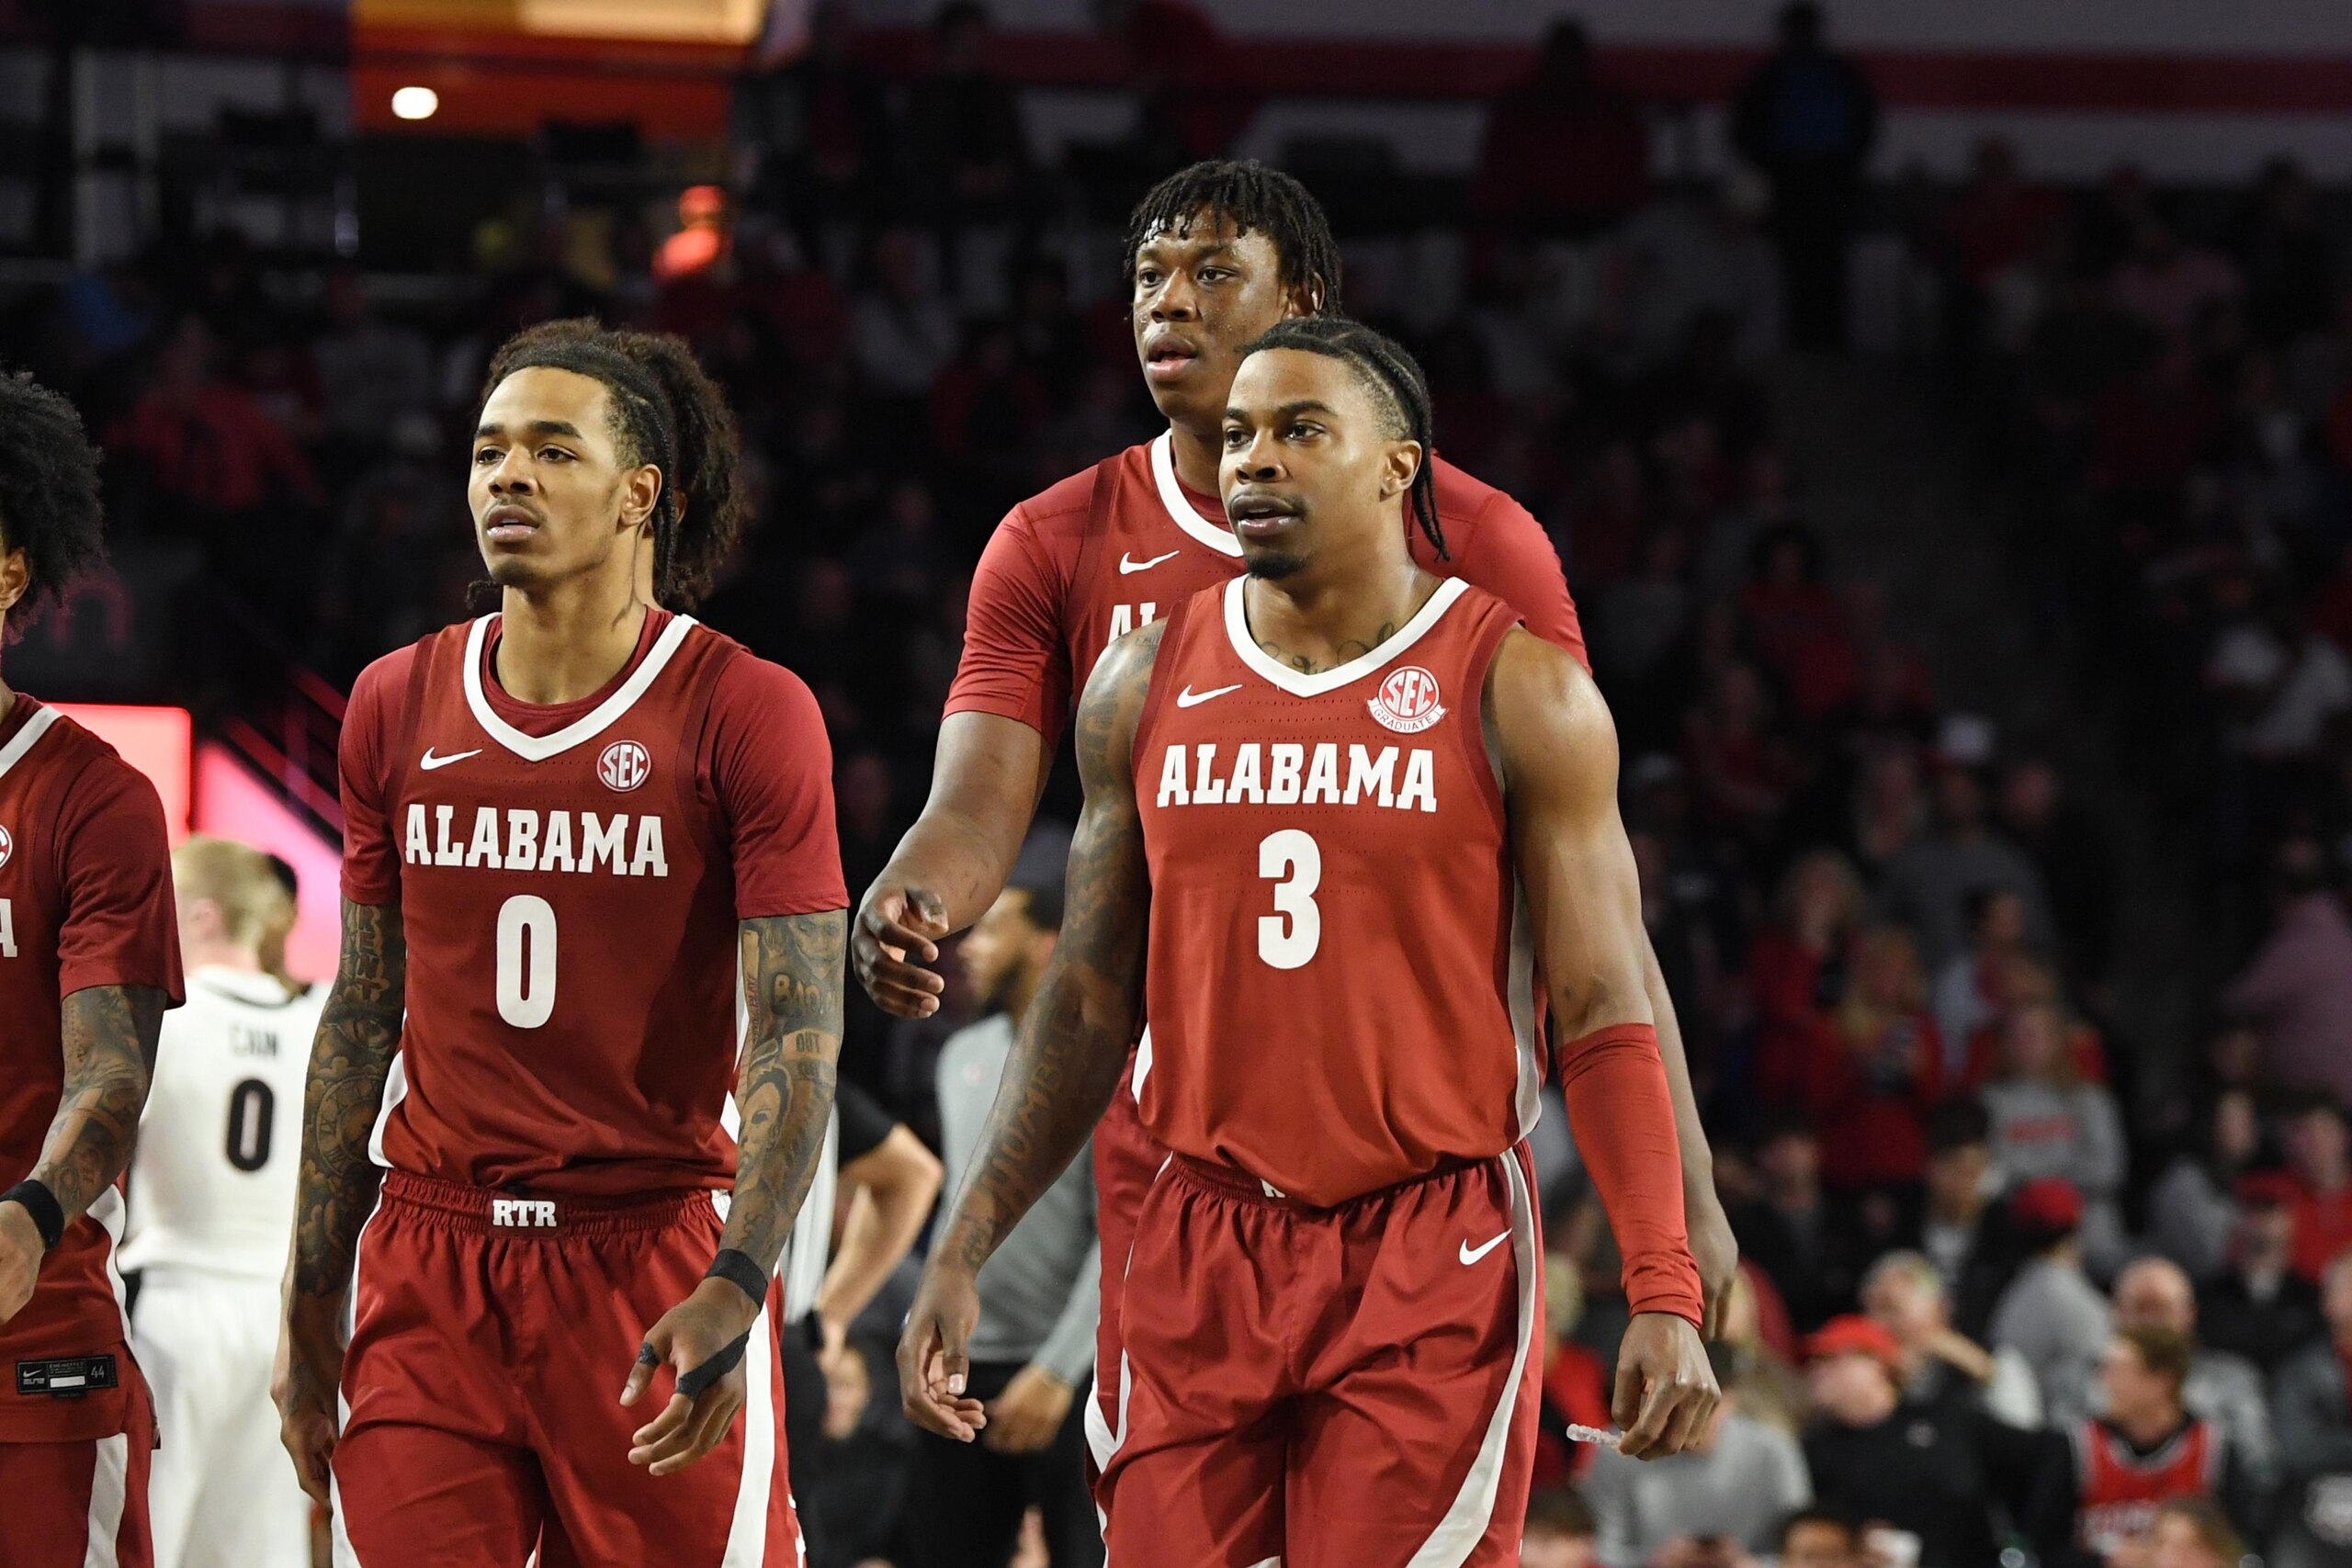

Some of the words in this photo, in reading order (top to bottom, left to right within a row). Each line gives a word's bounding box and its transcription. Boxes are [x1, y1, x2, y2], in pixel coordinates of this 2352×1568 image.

[1374, 708, 1434, 732] GRADUATE
[1384, 670, 1434, 716] SEC
[602, 743, 647, 789] SEC
[1156, 742, 1438, 813] ALABAMA
[405, 803, 669, 877] ALABAMA
[1258, 829, 1322, 970] 3
[495, 894, 558, 1030] 0
[226, 1077, 275, 1173] 0
[492, 1199, 558, 1227] RTR
[90, 1365, 105, 1379] 44
